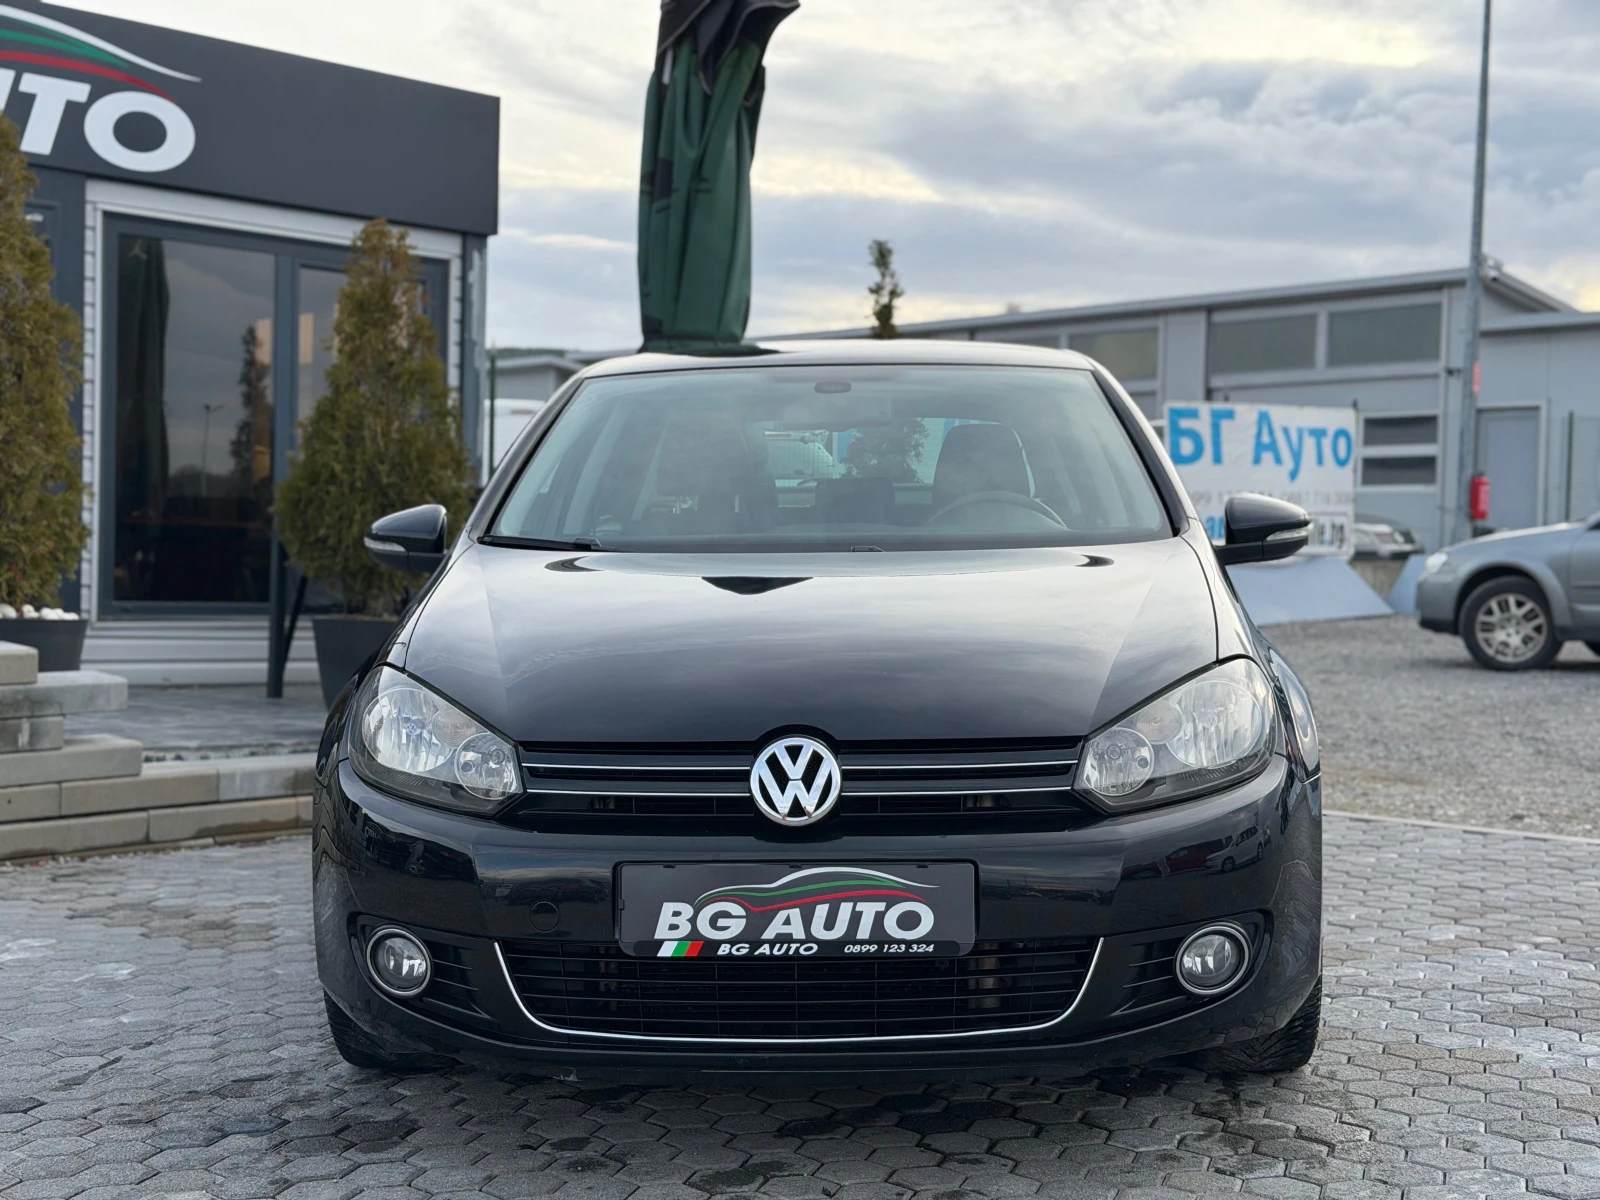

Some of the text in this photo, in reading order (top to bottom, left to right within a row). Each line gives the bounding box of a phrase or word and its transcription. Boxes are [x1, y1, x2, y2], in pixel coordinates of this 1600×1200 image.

[0, 67, 196, 173] TO
[1168, 406, 1354, 483] БГ Ауто
[752, 736, 840, 823] VW
[654, 901, 935, 940] BG AUTO
[717, 943, 935, 956] BG AUTO 0899 123 324
